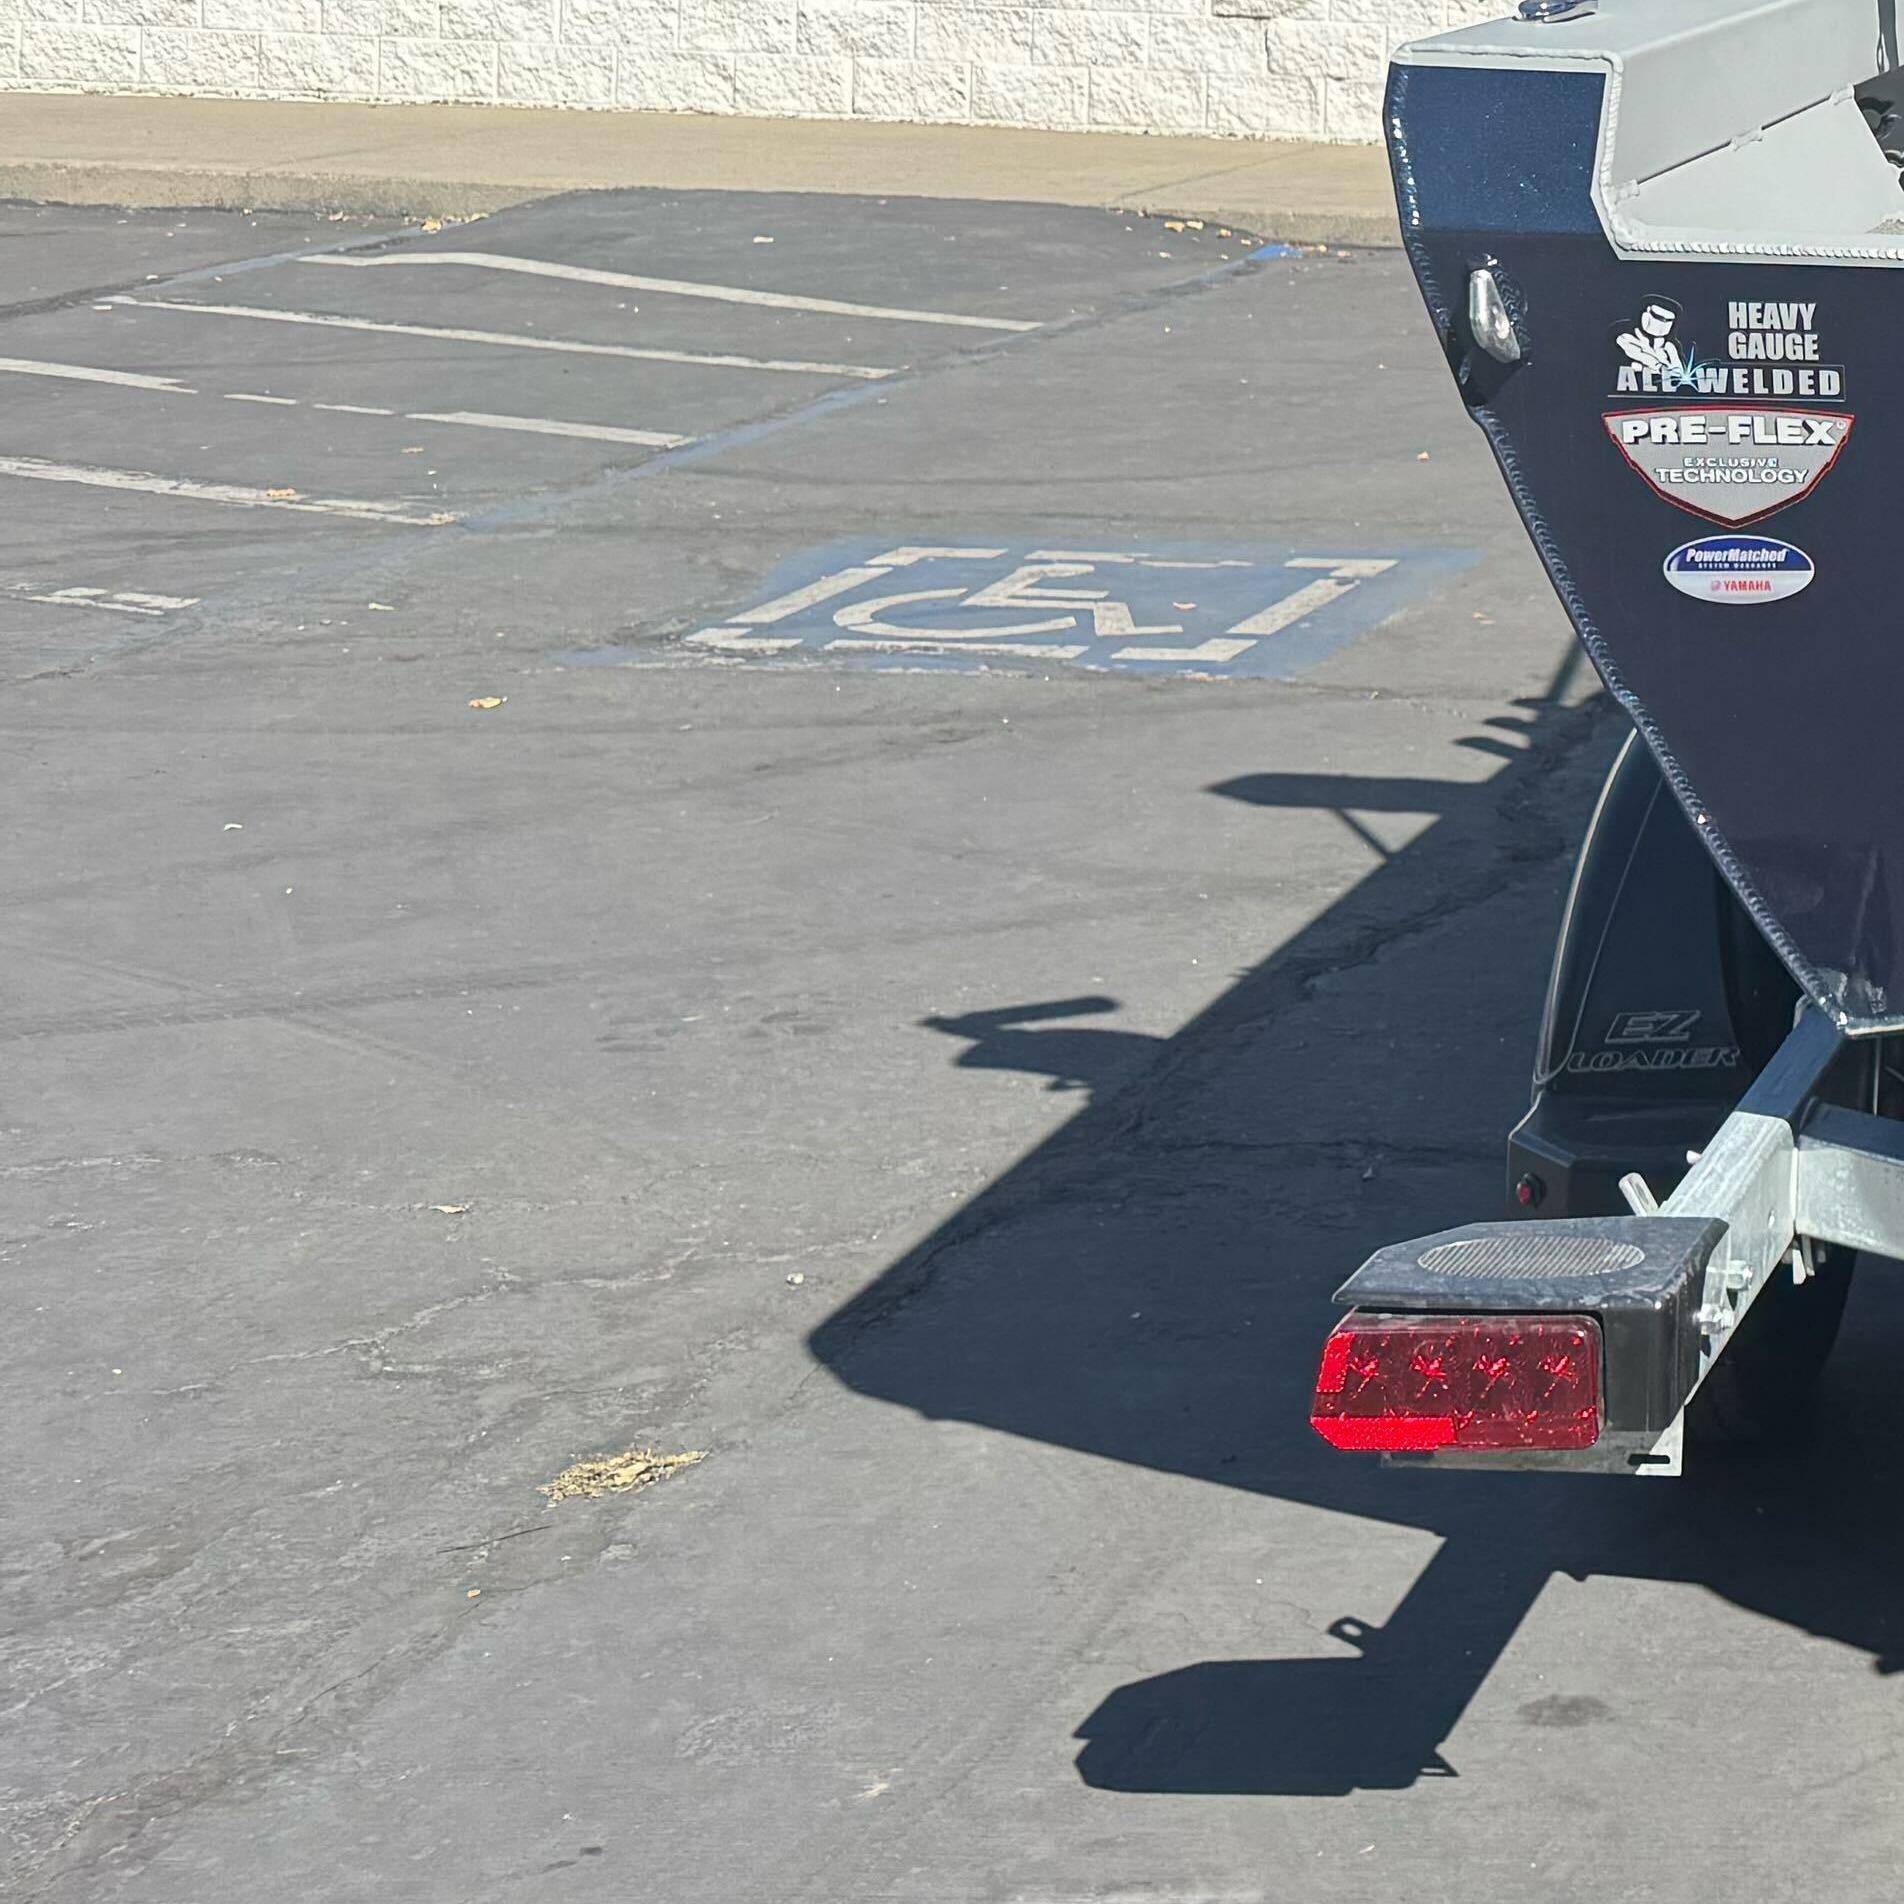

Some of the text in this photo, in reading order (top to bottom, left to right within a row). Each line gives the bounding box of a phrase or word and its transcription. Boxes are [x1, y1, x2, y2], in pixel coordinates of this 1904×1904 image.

[1728, 301, 1817, 331] HEAVY
[1728, 331, 1820, 362] GAUGE
[1616, 364, 1841, 395] ALL WELDED
[1655, 467, 1809, 484] TECHNOLOGY
[1684, 457, 1779, 468] EXCLUSIVE
[1685, 547, 1789, 563] PowerMatched
[1723, 580, 1772, 592] YAMAHA
[1604, 1009, 1701, 1044] EZ
[1567, 1047, 1741, 1073] LOADER
